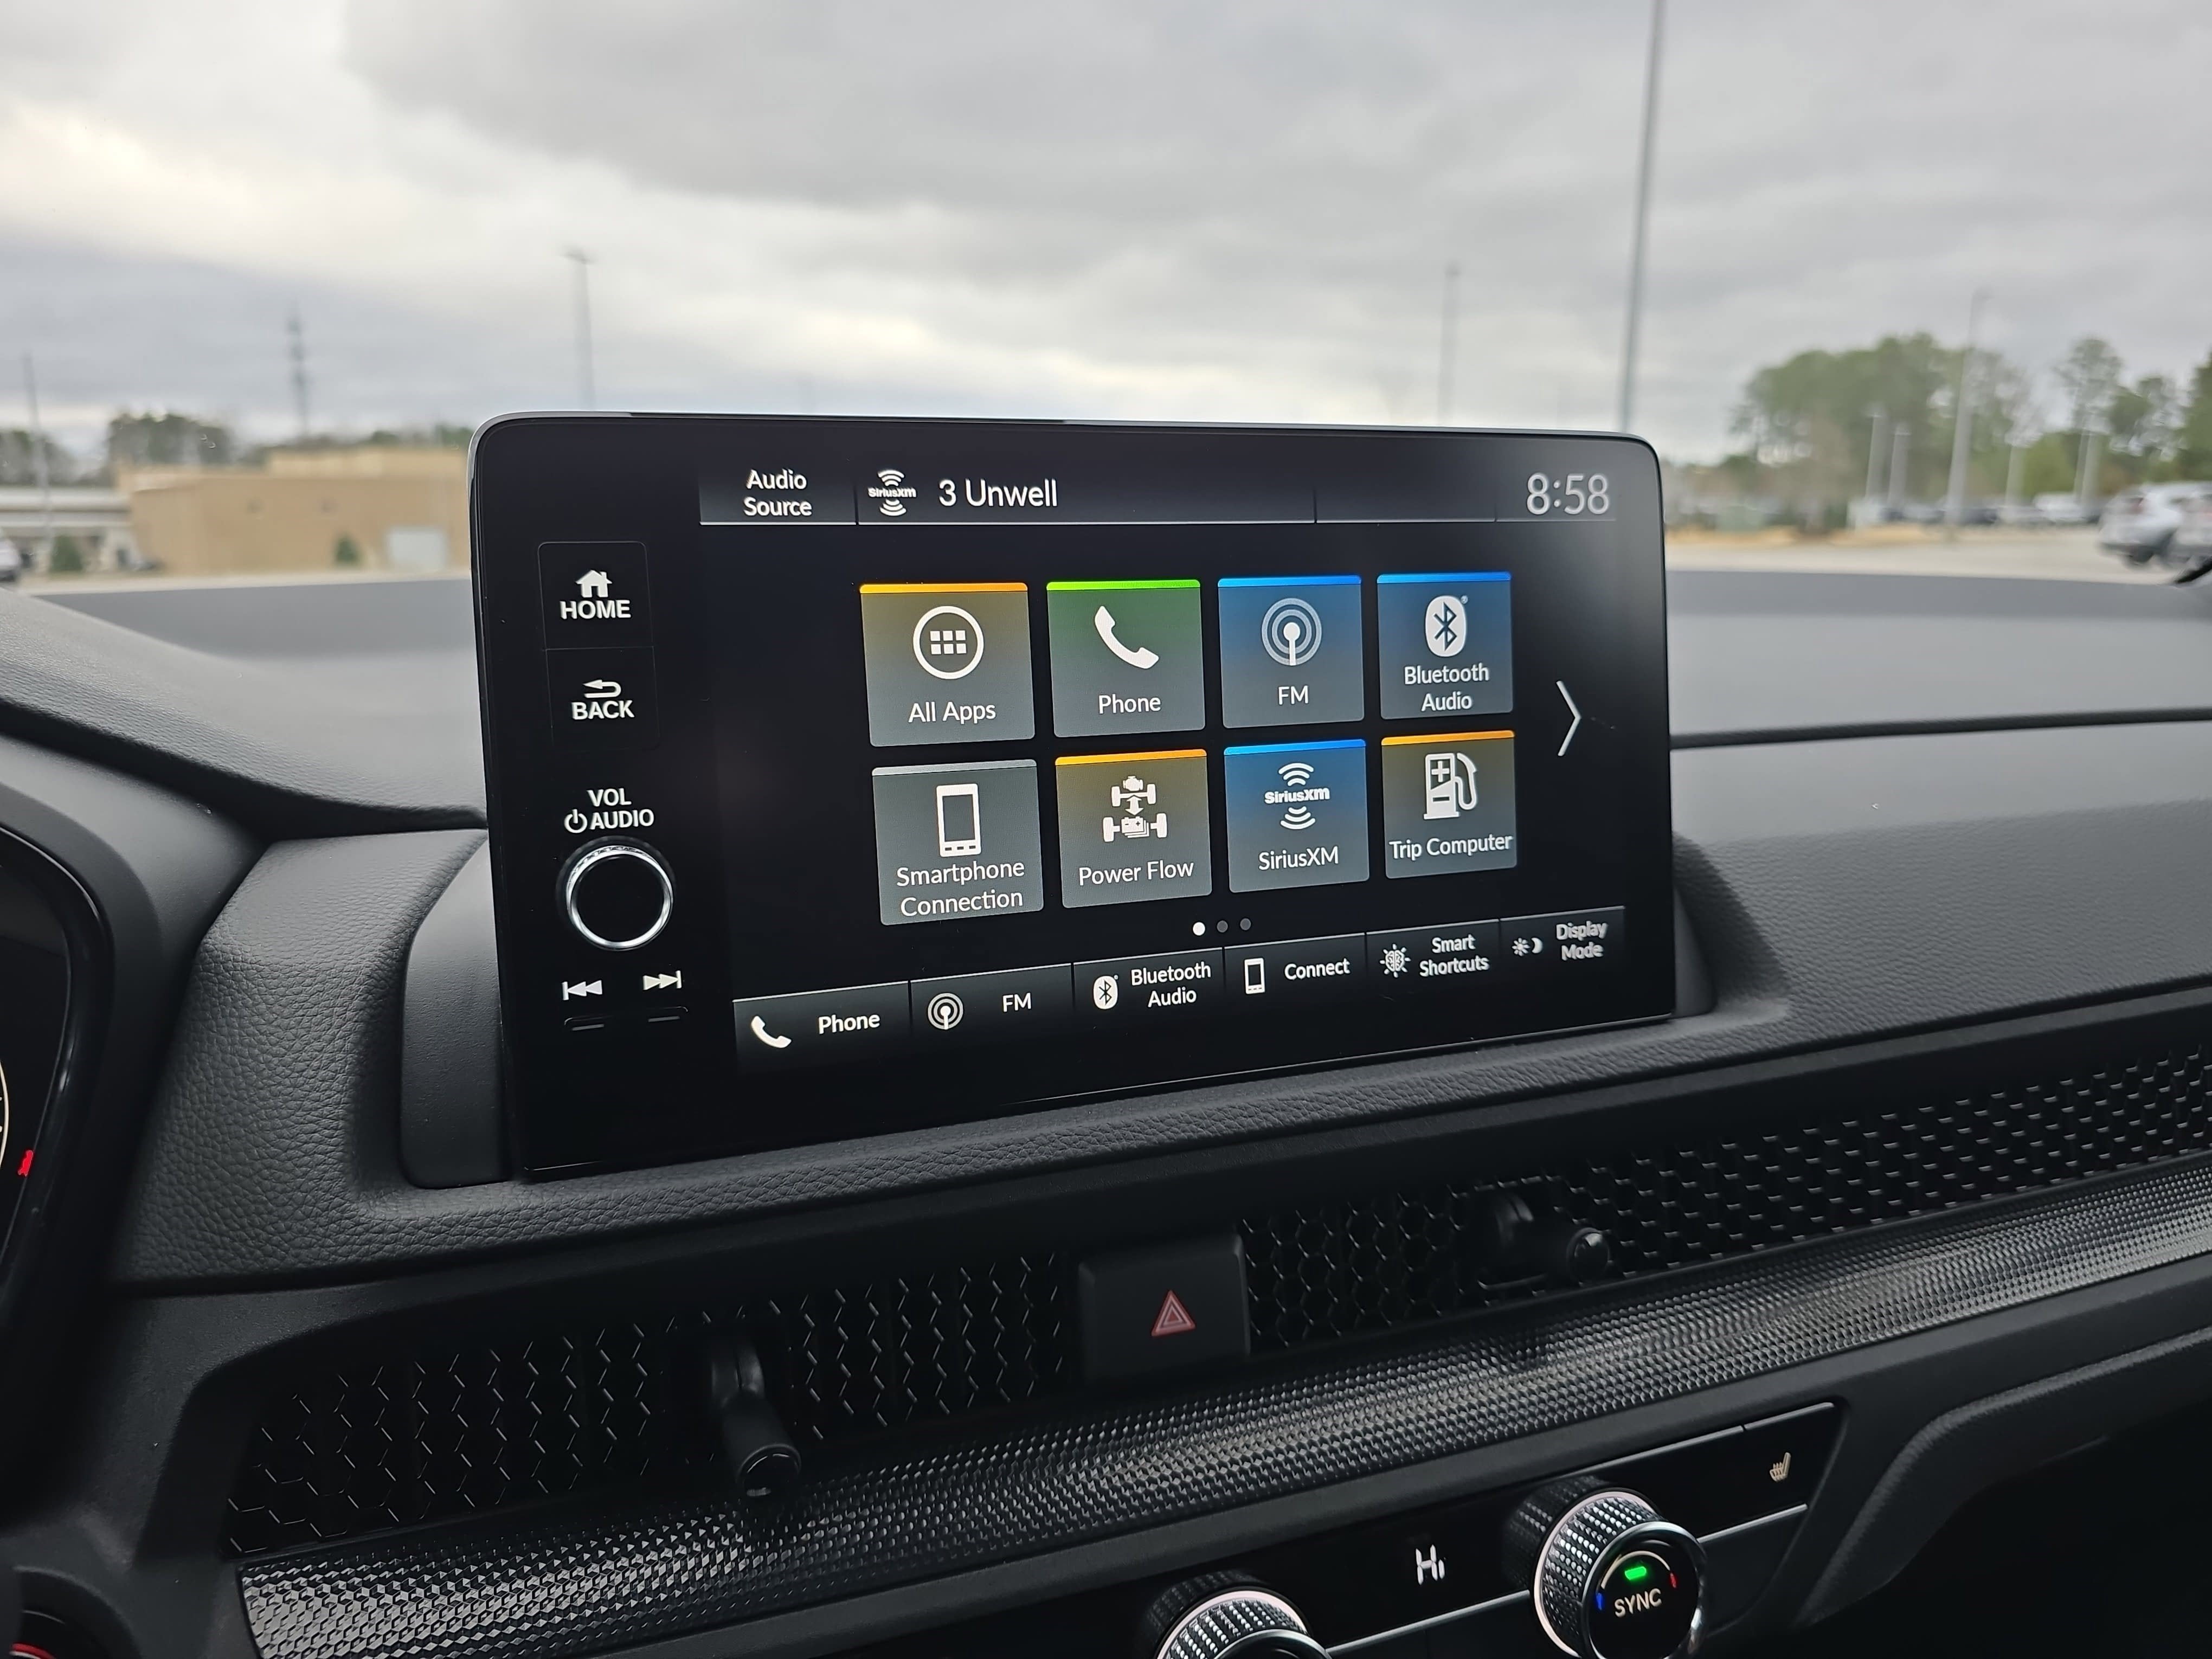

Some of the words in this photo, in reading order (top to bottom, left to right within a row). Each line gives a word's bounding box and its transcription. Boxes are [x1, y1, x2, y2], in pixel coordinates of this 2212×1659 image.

[746, 469, 807, 490] Audio
[939, 479, 956, 506] 3
[966, 479, 1057, 506] Unwell
[1527, 473, 1610, 515] 8:58
[744, 497, 812, 516] Source
[560, 600, 631, 620] HOME
[1404, 663, 1489, 685] Bluetooth
[1098, 693, 1161, 714] Phone
[1278, 685, 1308, 705] FM
[1421, 691, 1472, 712] Audio
[571, 700, 635, 720] BACK
[908, 701, 936, 723] All
[942, 702, 996, 724] Apps
[587, 788, 632, 807] VOL
[590, 809, 654, 830] AUDIO
[1259, 846, 1339, 870] SiriusXM
[1388, 839, 1422, 861] Trip
[1426, 834, 1513, 856] Computer
[897, 860, 1025, 886] Smartphone
[1079, 867, 1141, 886] Power
[1147, 860, 1194, 880] Flow
[901, 889, 1023, 916] Connection
[1556, 921, 1607, 942] Display
[1432, 934, 1476, 953] Smart
[1561, 941, 1603, 961] Mode
[1131, 961, 1211, 986] Bluetooth
[1284, 958, 1350, 980] Connect
[1419, 955, 1489, 977] Shortcuts
[1002, 992, 1031, 1012] FM
[1148, 986, 1197, 1007] Audio
[818, 1014, 880, 1034] Phone
[1615, 1588, 1662, 1617] SYNC
